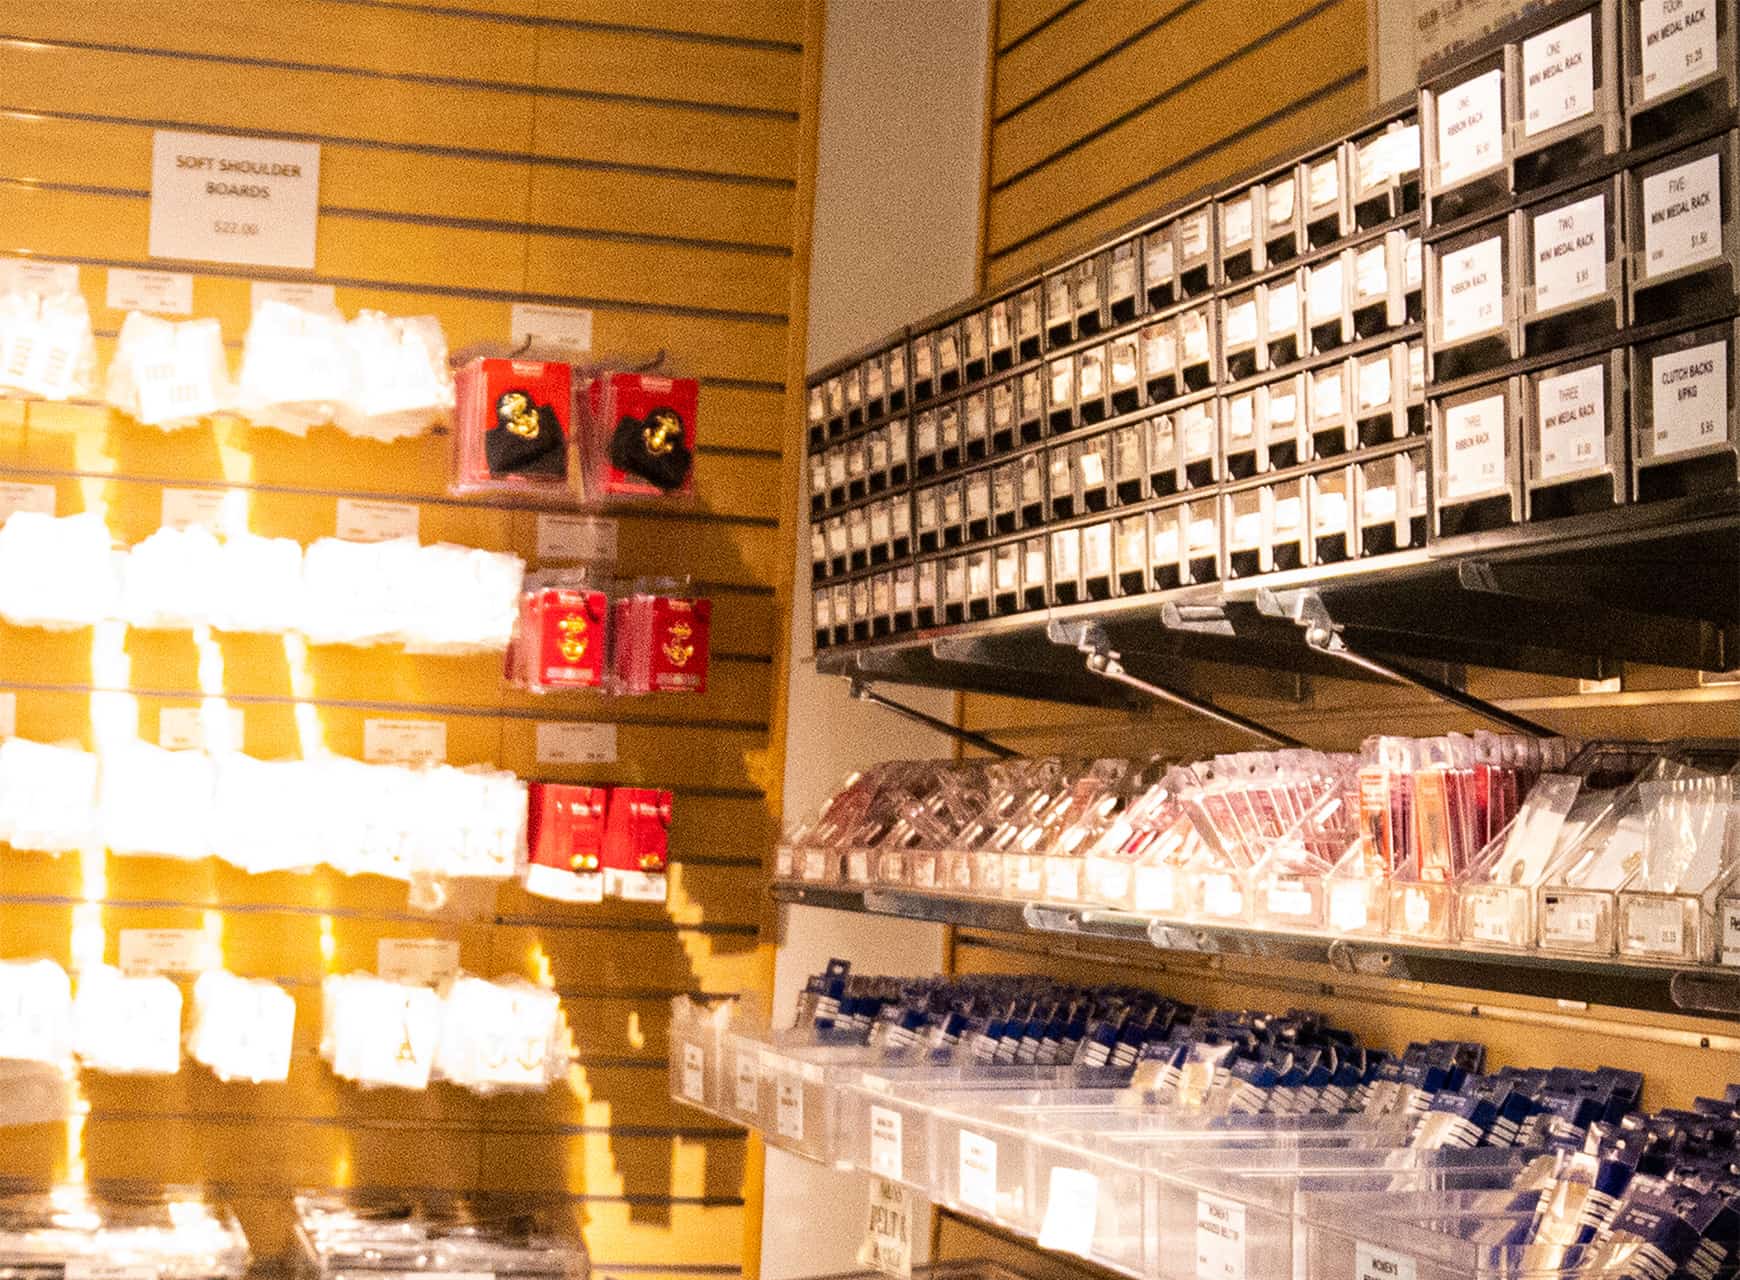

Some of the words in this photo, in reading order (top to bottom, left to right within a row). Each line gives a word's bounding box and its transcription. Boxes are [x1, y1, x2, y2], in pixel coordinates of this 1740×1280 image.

[1685, 8, 1705, 28] RACK
[1565, 53, 1583, 70] RACK
[175, 154, 214, 170] SOFT
[218, 157, 302, 178] SHOULDER
[205, 180, 271, 200] BOARDS
[1668, 175, 1685, 194] FIVE
[1691, 191, 1710, 210] RACK
[1559, 216, 1575, 231] TWO
[1576, 233, 1595, 248] RACK
[1662, 367, 1688, 385] CLUTCH
[1689, 360, 1714, 379] BACKS
[1559, 385, 1580, 402] THREE
[1578, 402, 1596, 418] RACK
